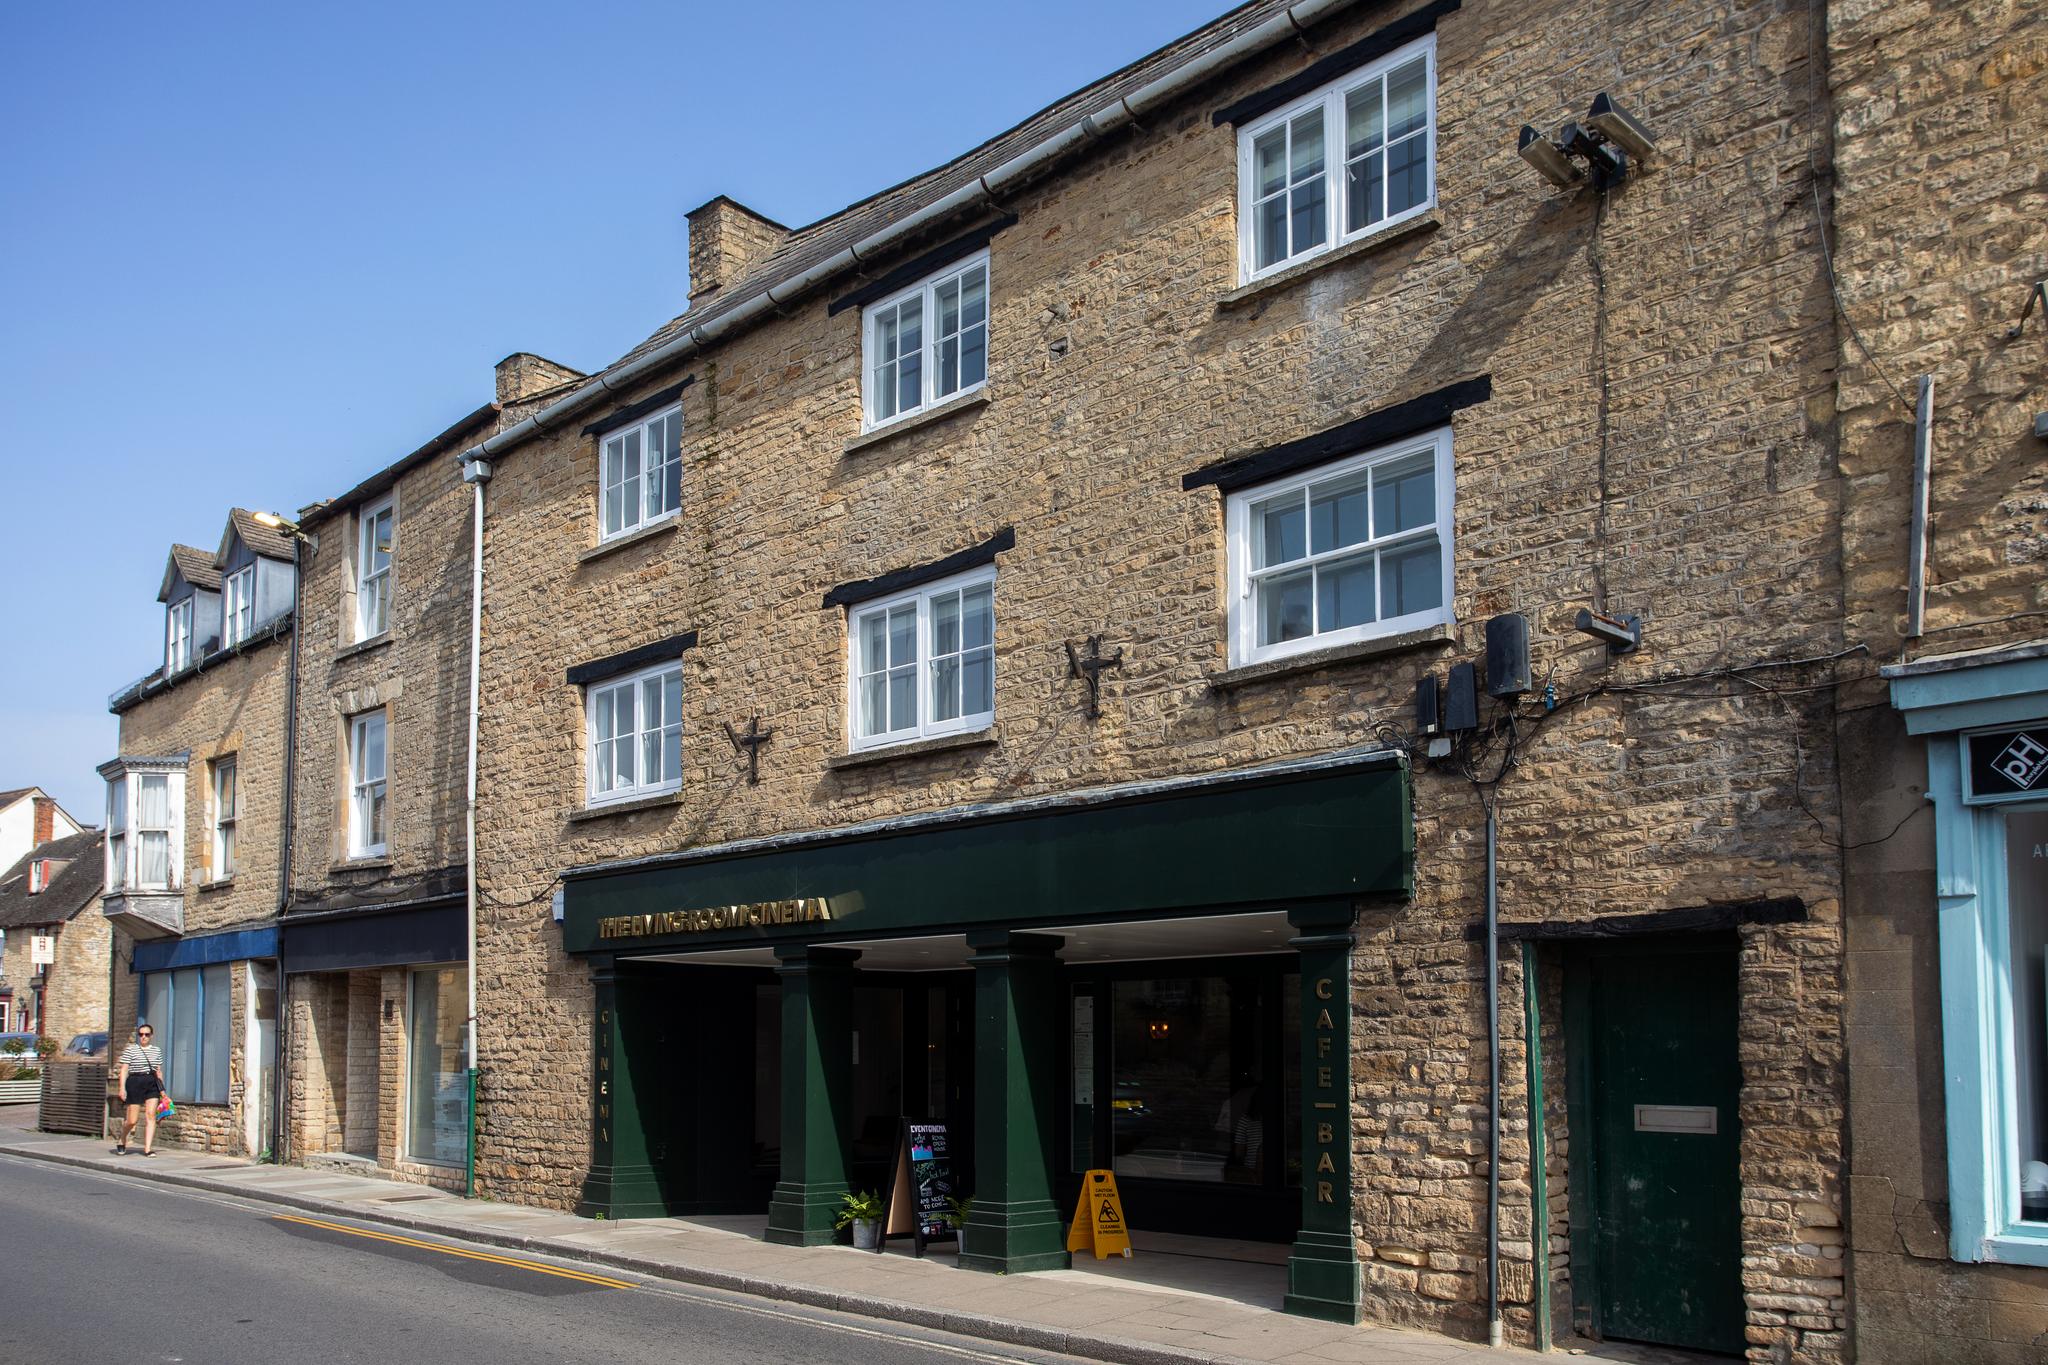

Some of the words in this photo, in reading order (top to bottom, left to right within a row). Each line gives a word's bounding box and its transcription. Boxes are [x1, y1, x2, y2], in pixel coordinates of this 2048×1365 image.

[598, 916, 631, 938] THE
[631, 910, 687, 936] LIVING
[687, 904, 748, 931] ROOM
[748, 897, 831, 927] CINEMA
[600, 1010, 609, 1143] CINEMA
